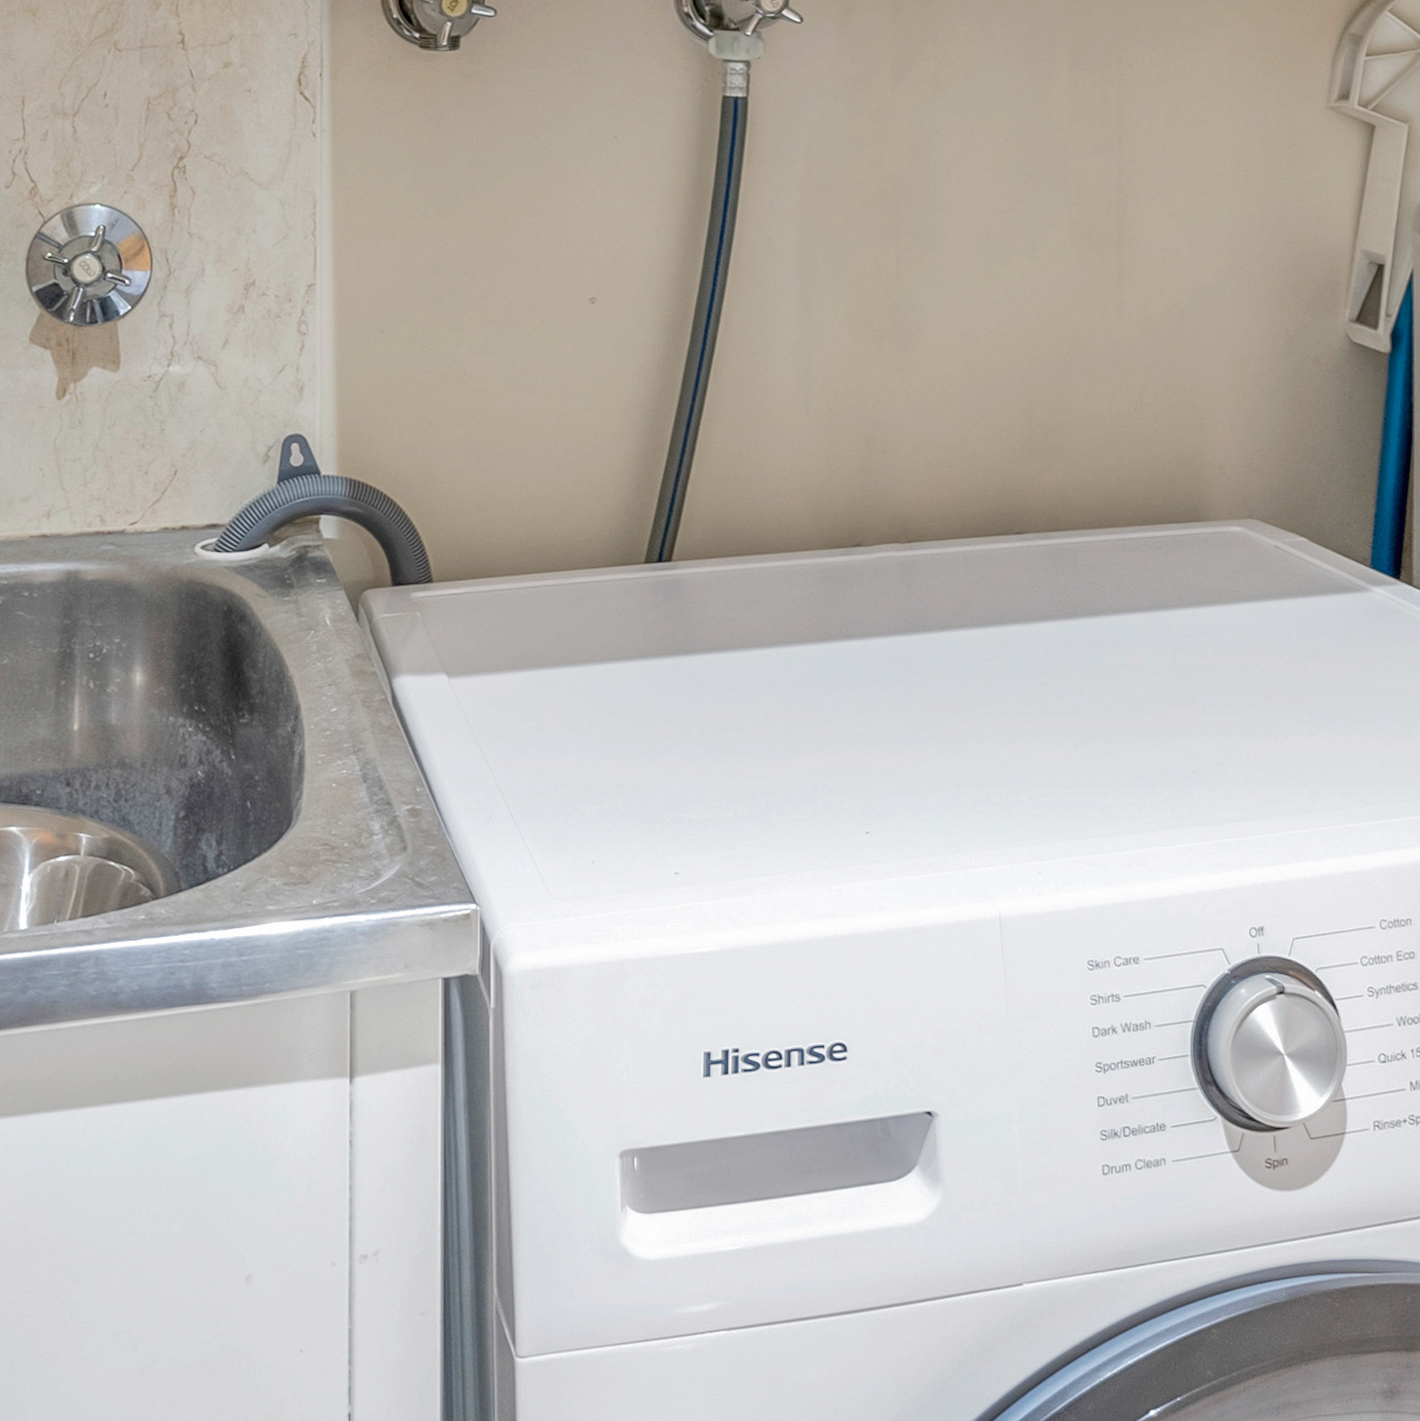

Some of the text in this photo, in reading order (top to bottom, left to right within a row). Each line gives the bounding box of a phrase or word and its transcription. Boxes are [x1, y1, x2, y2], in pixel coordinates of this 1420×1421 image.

[79, 260, 96, 277] COLD
[1248, 925, 1264, 938] Off
[1379, 916, 1413, 931] Cotton
[1086, 954, 1139, 971] Skin Care
[1359, 949, 1416, 967] Cotton Eco
[1366, 980, 1419, 999] Synthetics
[1089, 991, 1121, 1006] Shirts
[1091, 1019, 1152, 1038] Dark Wash
[702, 1041, 848, 1078] Hisense
[1094, 1054, 1156, 1074] Sportswear
[1377, 1050, 1408, 1065] Quick
[1096, 1093, 1130, 1107] Duvet
[1099, 1121, 1166, 1141] Silk/Delicate
[1101, 1156, 1166, 1176] Drum Clean
[1264, 1156, 1289, 1171] Spin
